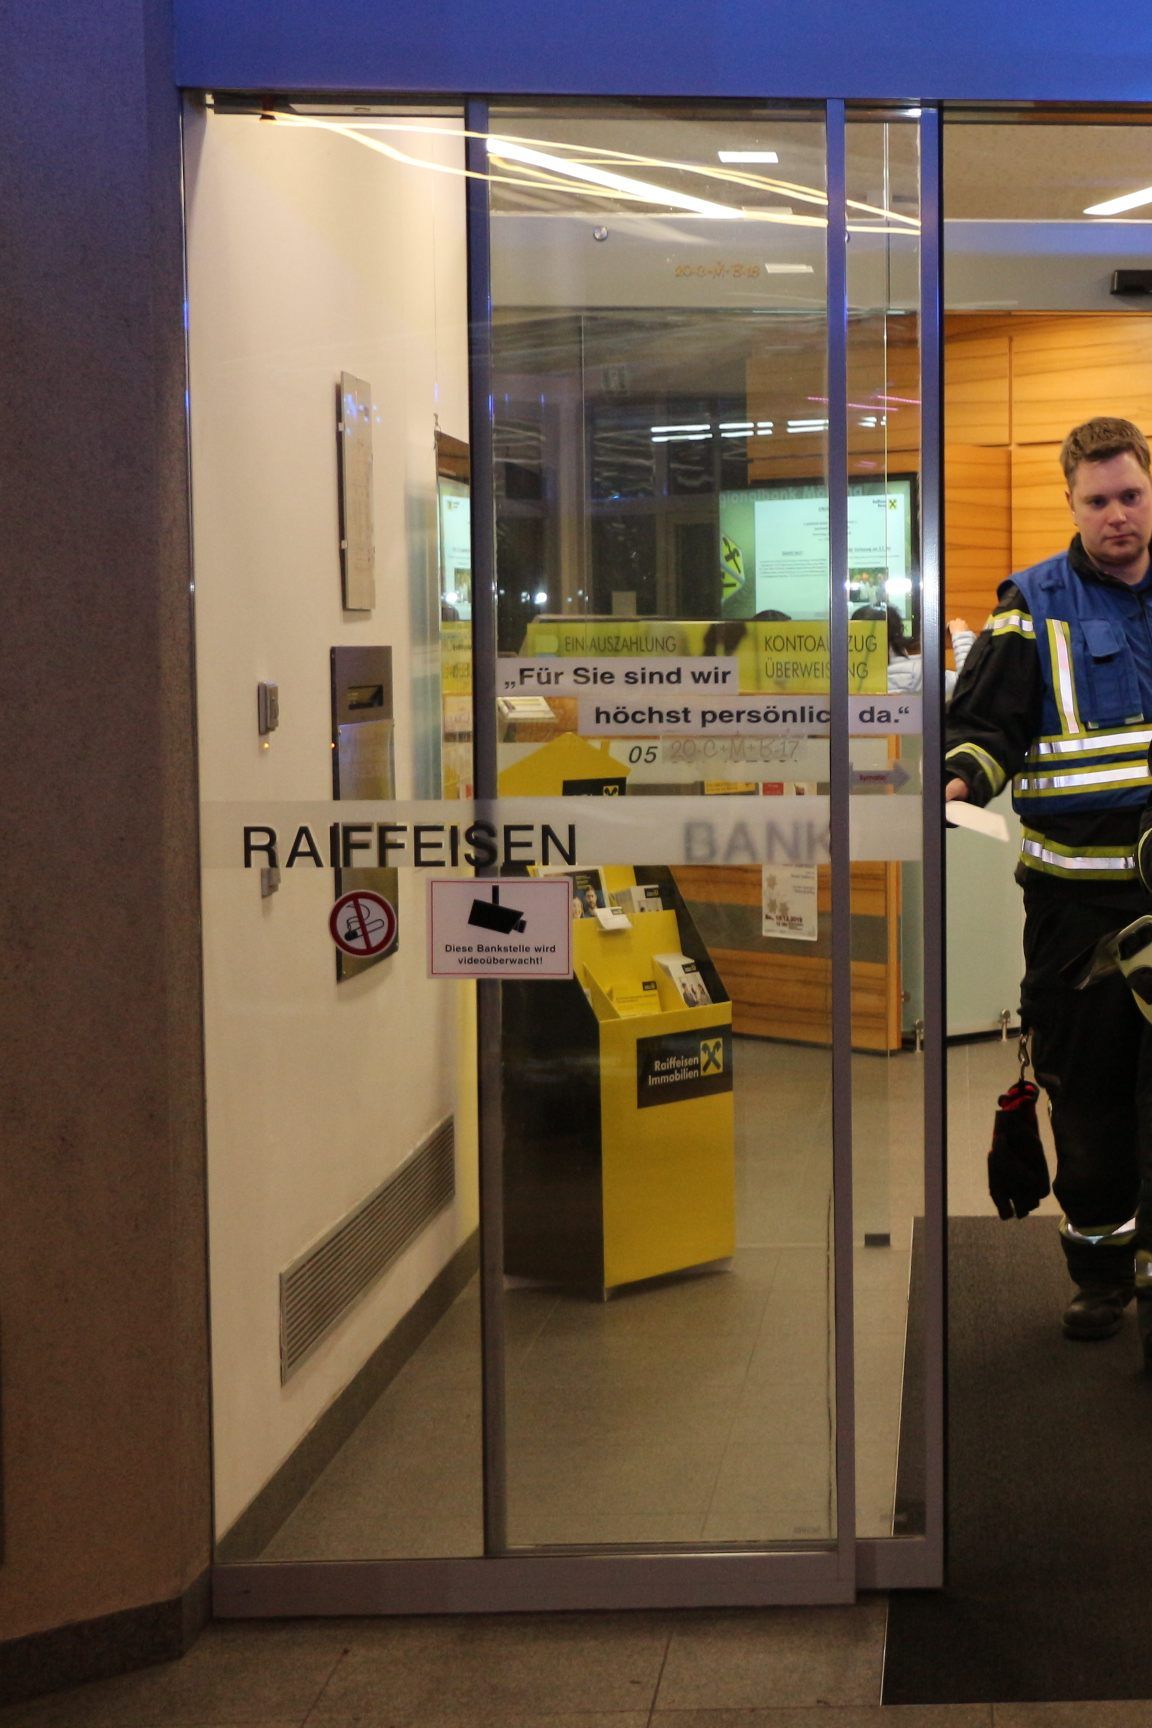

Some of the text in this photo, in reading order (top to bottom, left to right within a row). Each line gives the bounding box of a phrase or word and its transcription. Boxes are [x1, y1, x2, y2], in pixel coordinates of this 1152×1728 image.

[764, 634, 877, 653] KONTOAZUG
[573, 667, 615, 685] Sie
[624, 667, 682, 685] sind
[690, 667, 731, 685] wir
[764, 656, 869, 679] ÜBERWEISNG
[595, 706, 691, 724] höchst
[701, 705, 831, 728] persönlic
[628, 745, 658, 764] 05
[243, 822, 577, 868] RAIFFEISEN
[445, 944, 556, 953] Diese Bankstelle wird
[458, 956, 543, 965] videoüberwacht!
[654, 1055, 699, 1072] Raiffeisen
[648, 1068, 699, 1086] Immobilien
